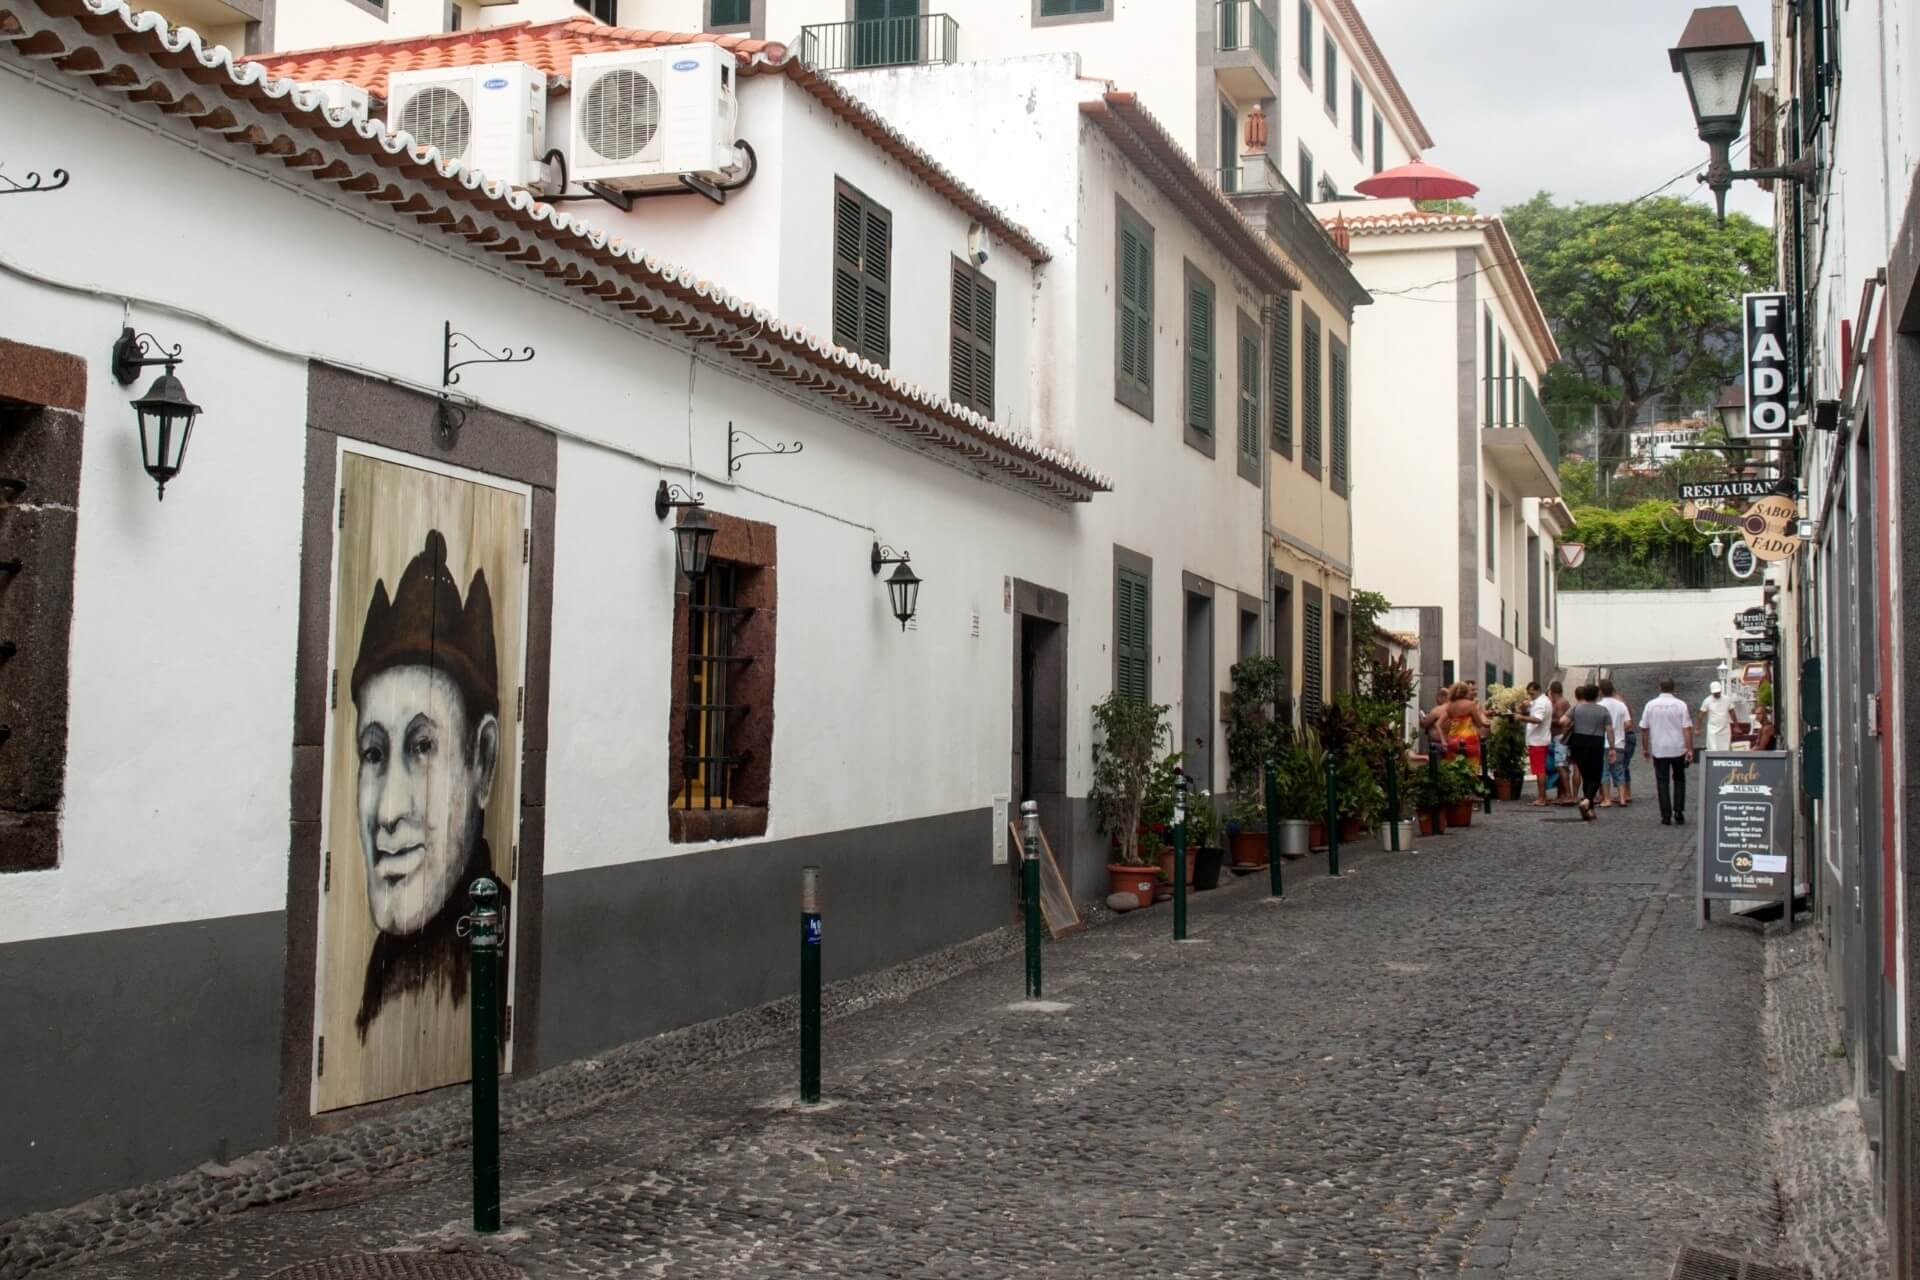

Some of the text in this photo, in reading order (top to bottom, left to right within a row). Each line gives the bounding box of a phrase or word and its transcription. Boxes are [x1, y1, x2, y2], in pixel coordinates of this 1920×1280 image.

[1751, 299, 1786, 431] FADO
[1682, 481, 1778, 498] RESTAURAN
[1751, 536, 1795, 555] FADO
